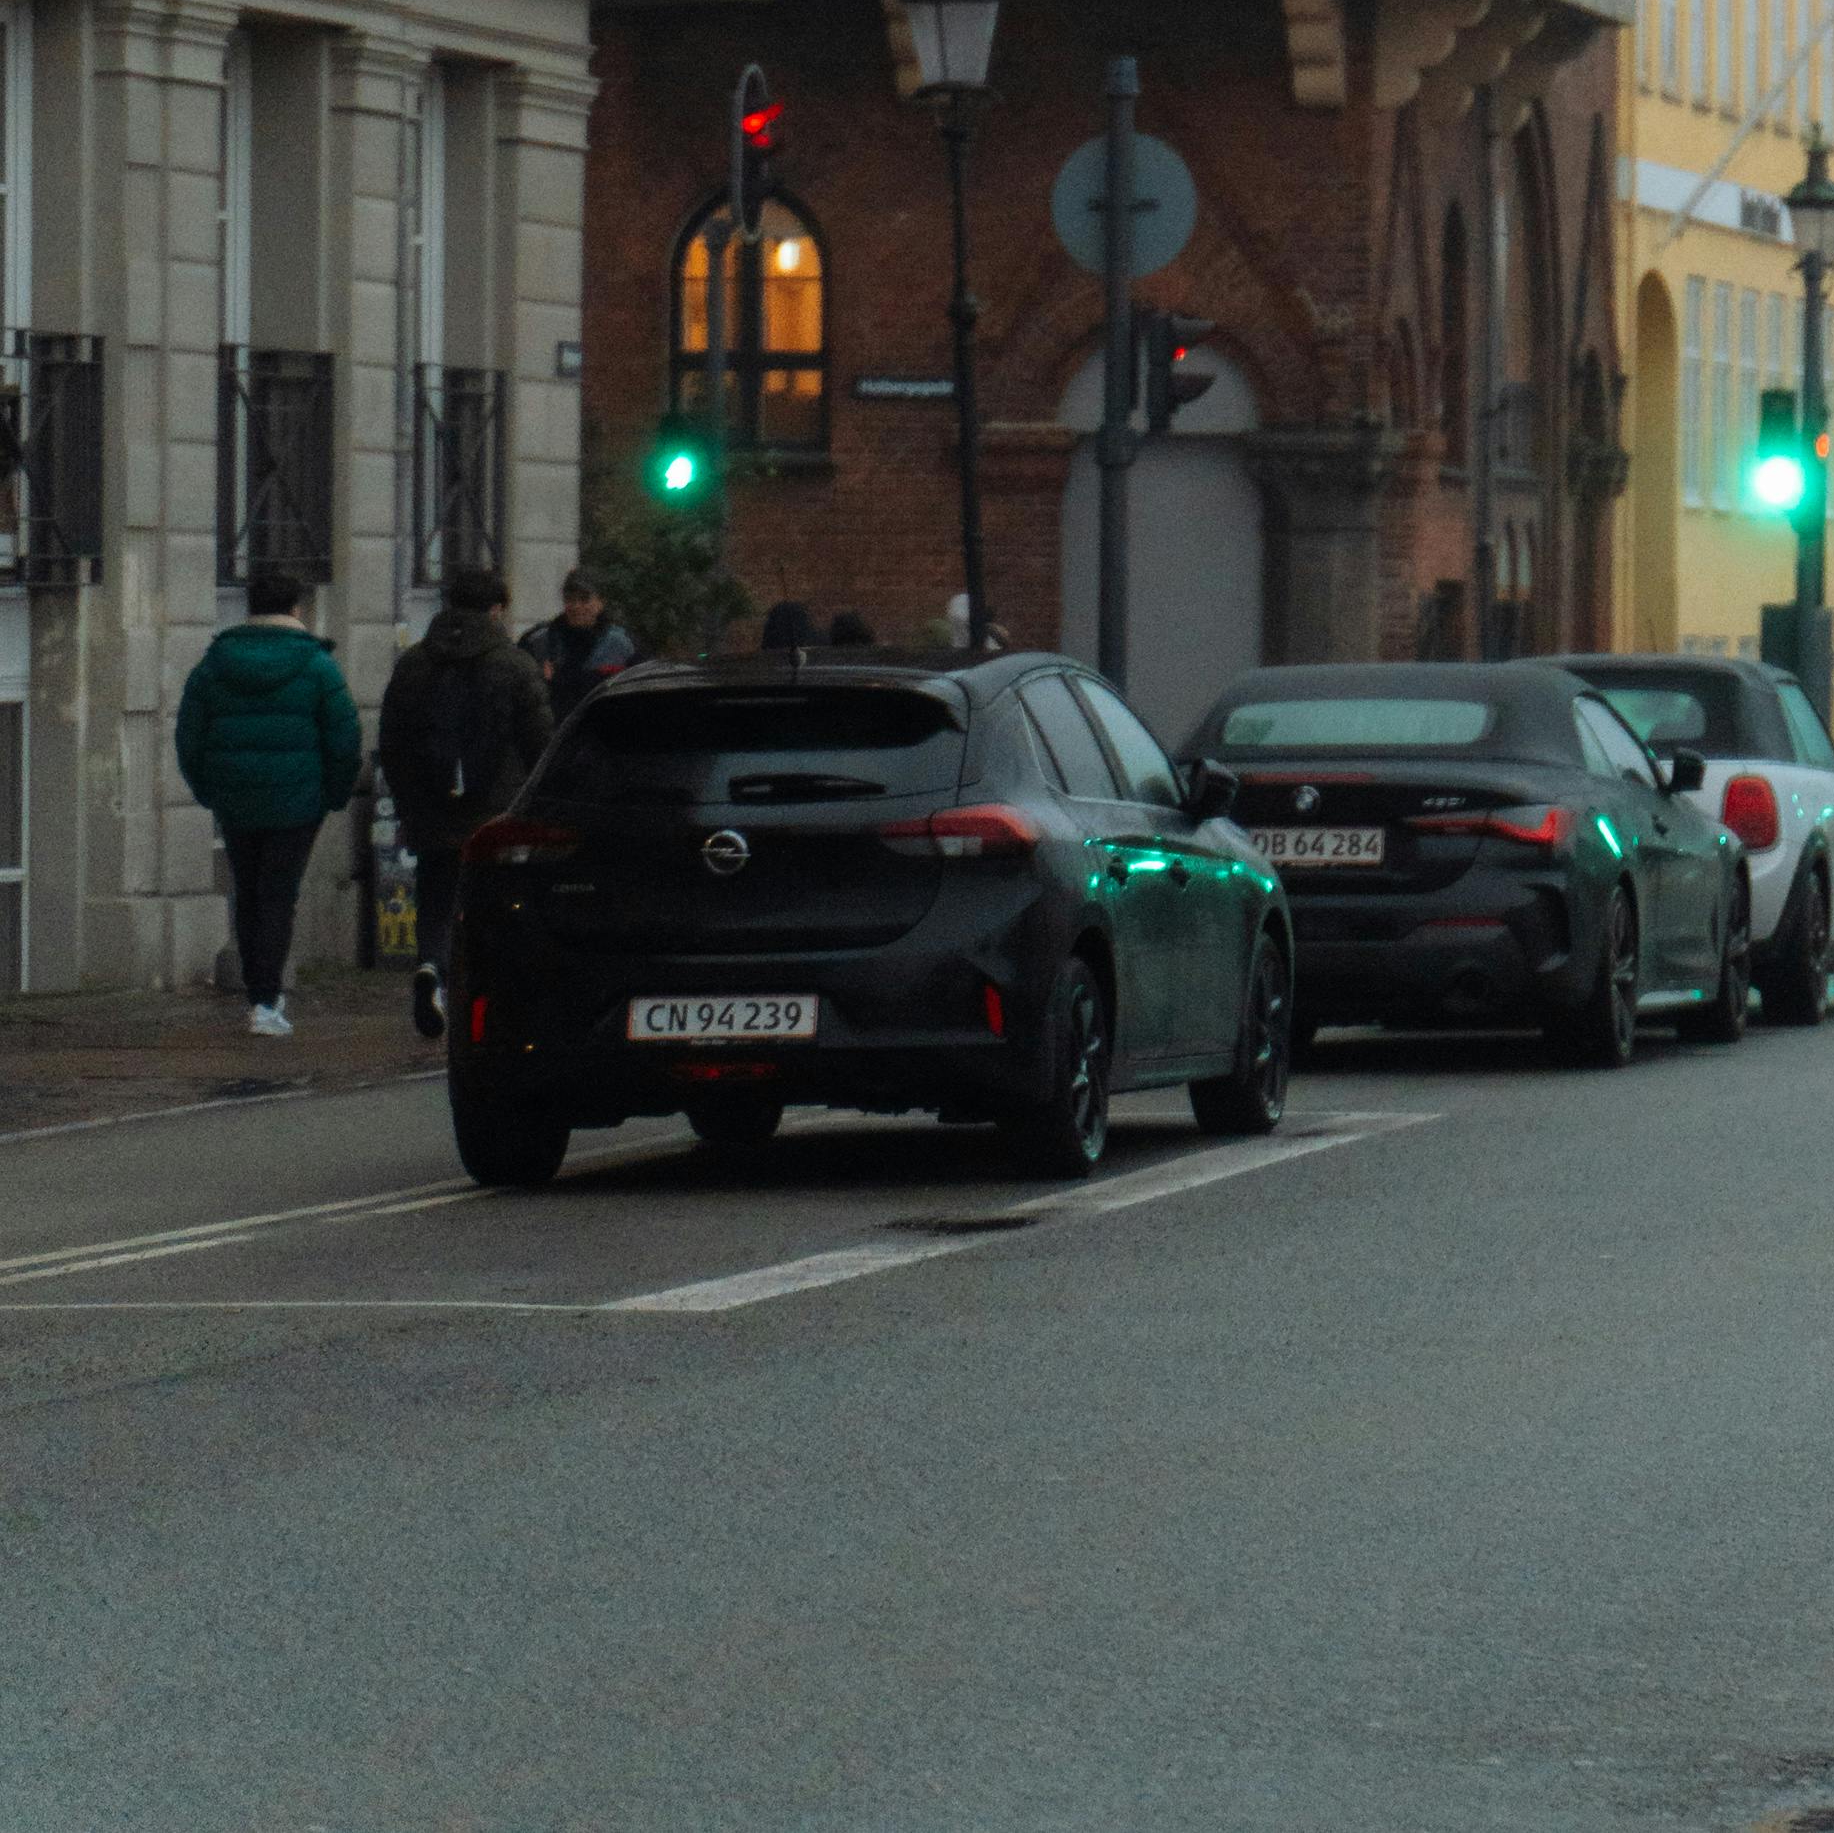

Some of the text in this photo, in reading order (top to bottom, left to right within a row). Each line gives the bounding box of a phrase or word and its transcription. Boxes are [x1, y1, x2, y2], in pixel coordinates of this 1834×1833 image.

[1294, 833, 1324, 856] 64
[1332, 833, 1378, 856] 284
[646, 1001, 802, 1032] CN 94 239
